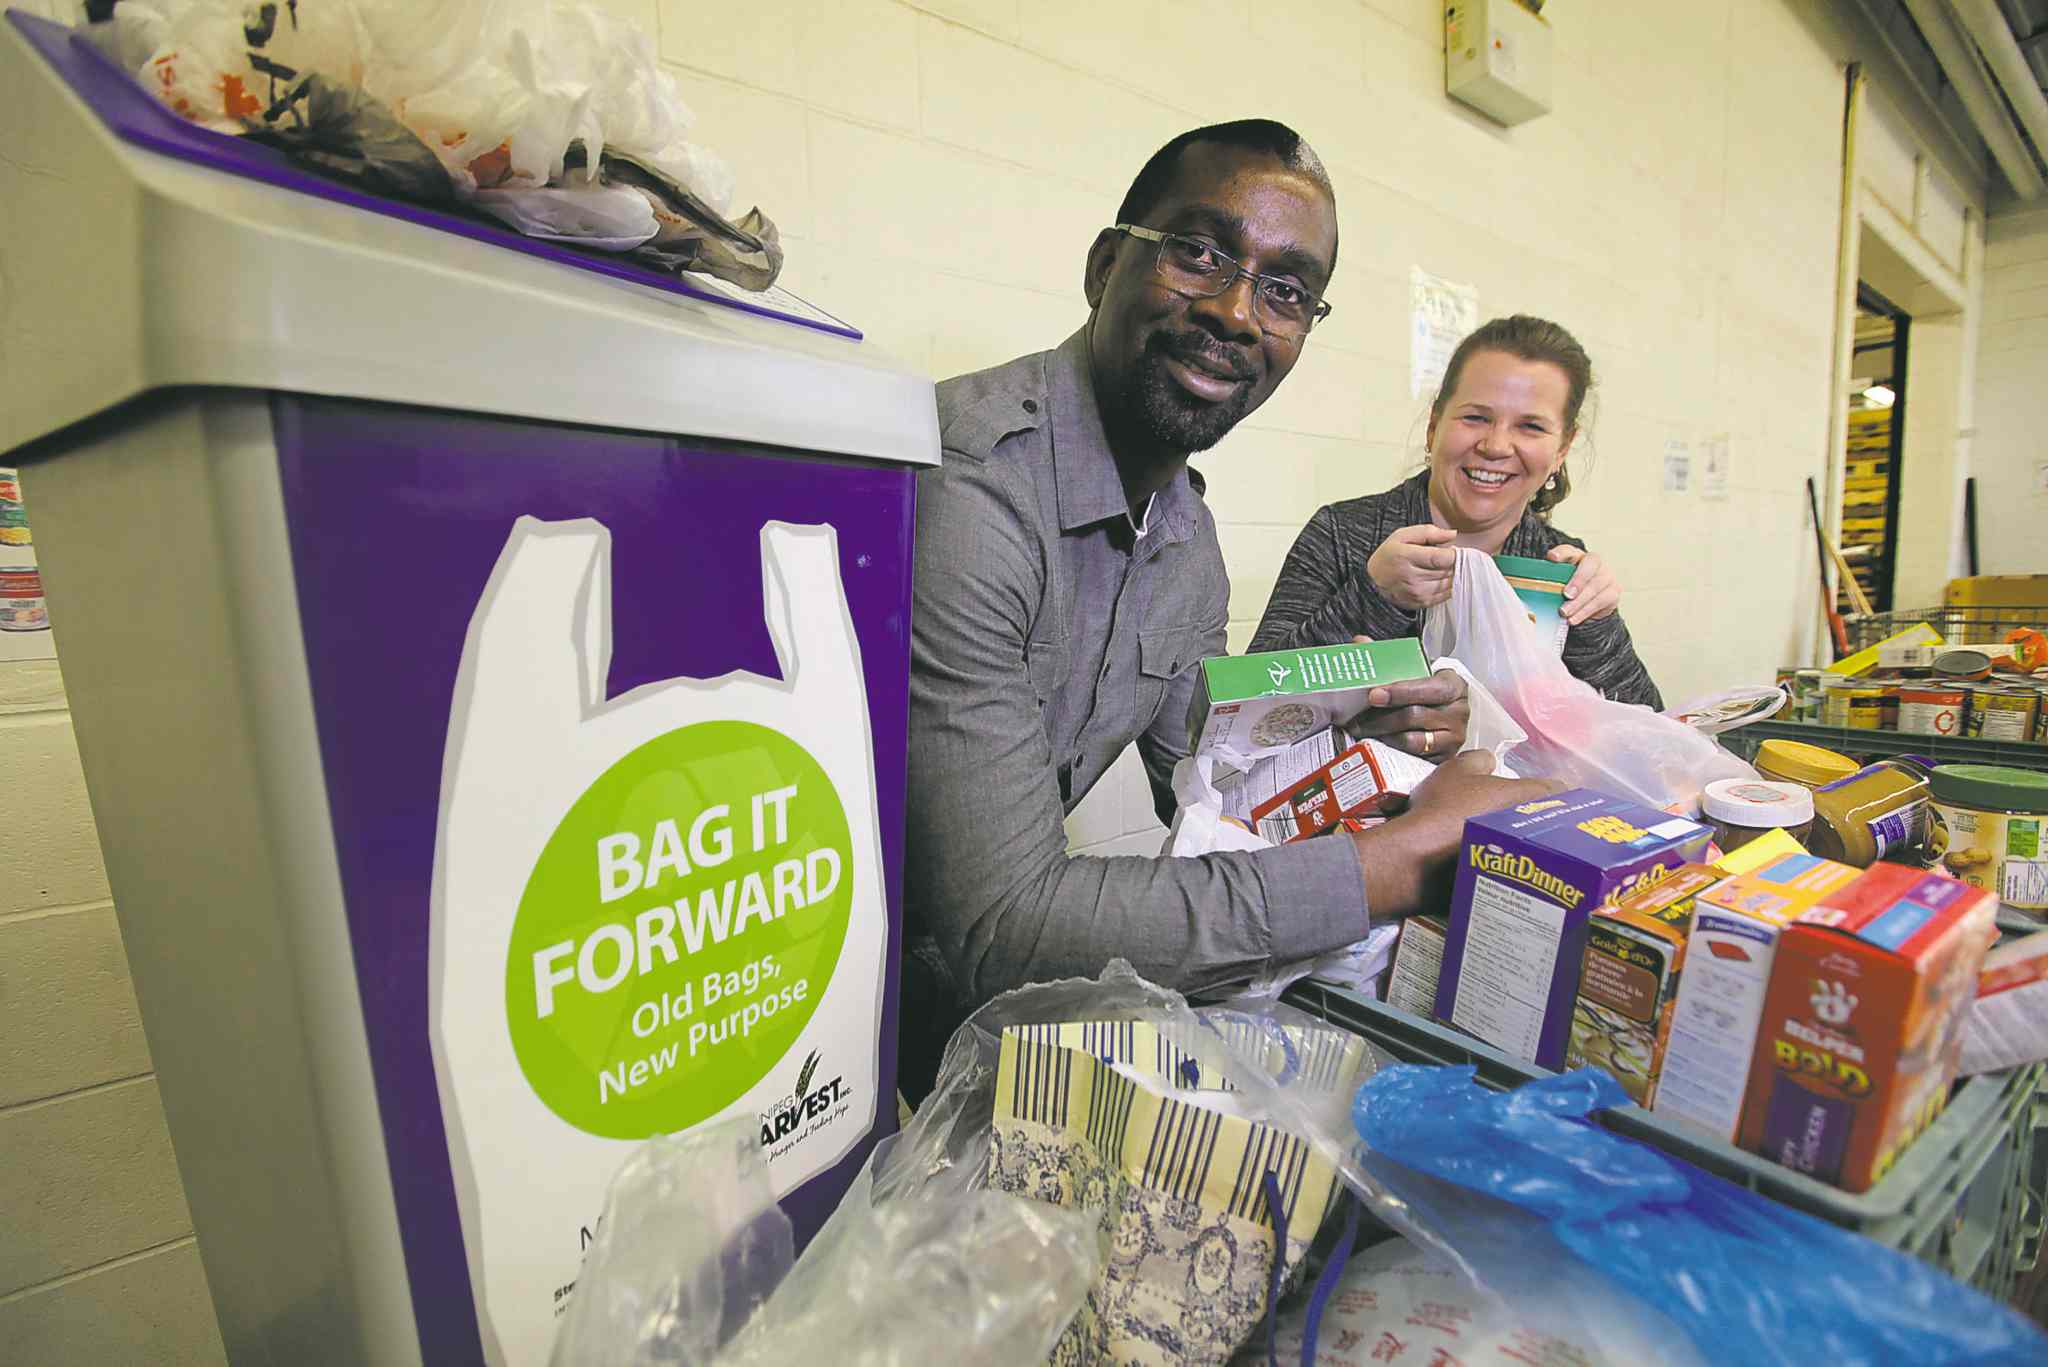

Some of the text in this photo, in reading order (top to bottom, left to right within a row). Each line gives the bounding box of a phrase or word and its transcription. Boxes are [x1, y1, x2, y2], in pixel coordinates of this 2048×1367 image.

[597, 785, 797, 904] BAG IT
[532, 847, 841, 1020] FORWARD
[600, 978, 808, 1104] New Purpose
[632, 954, 782, 1038] Old Bags,
[757, 1095, 794, 1125] NIPEG
